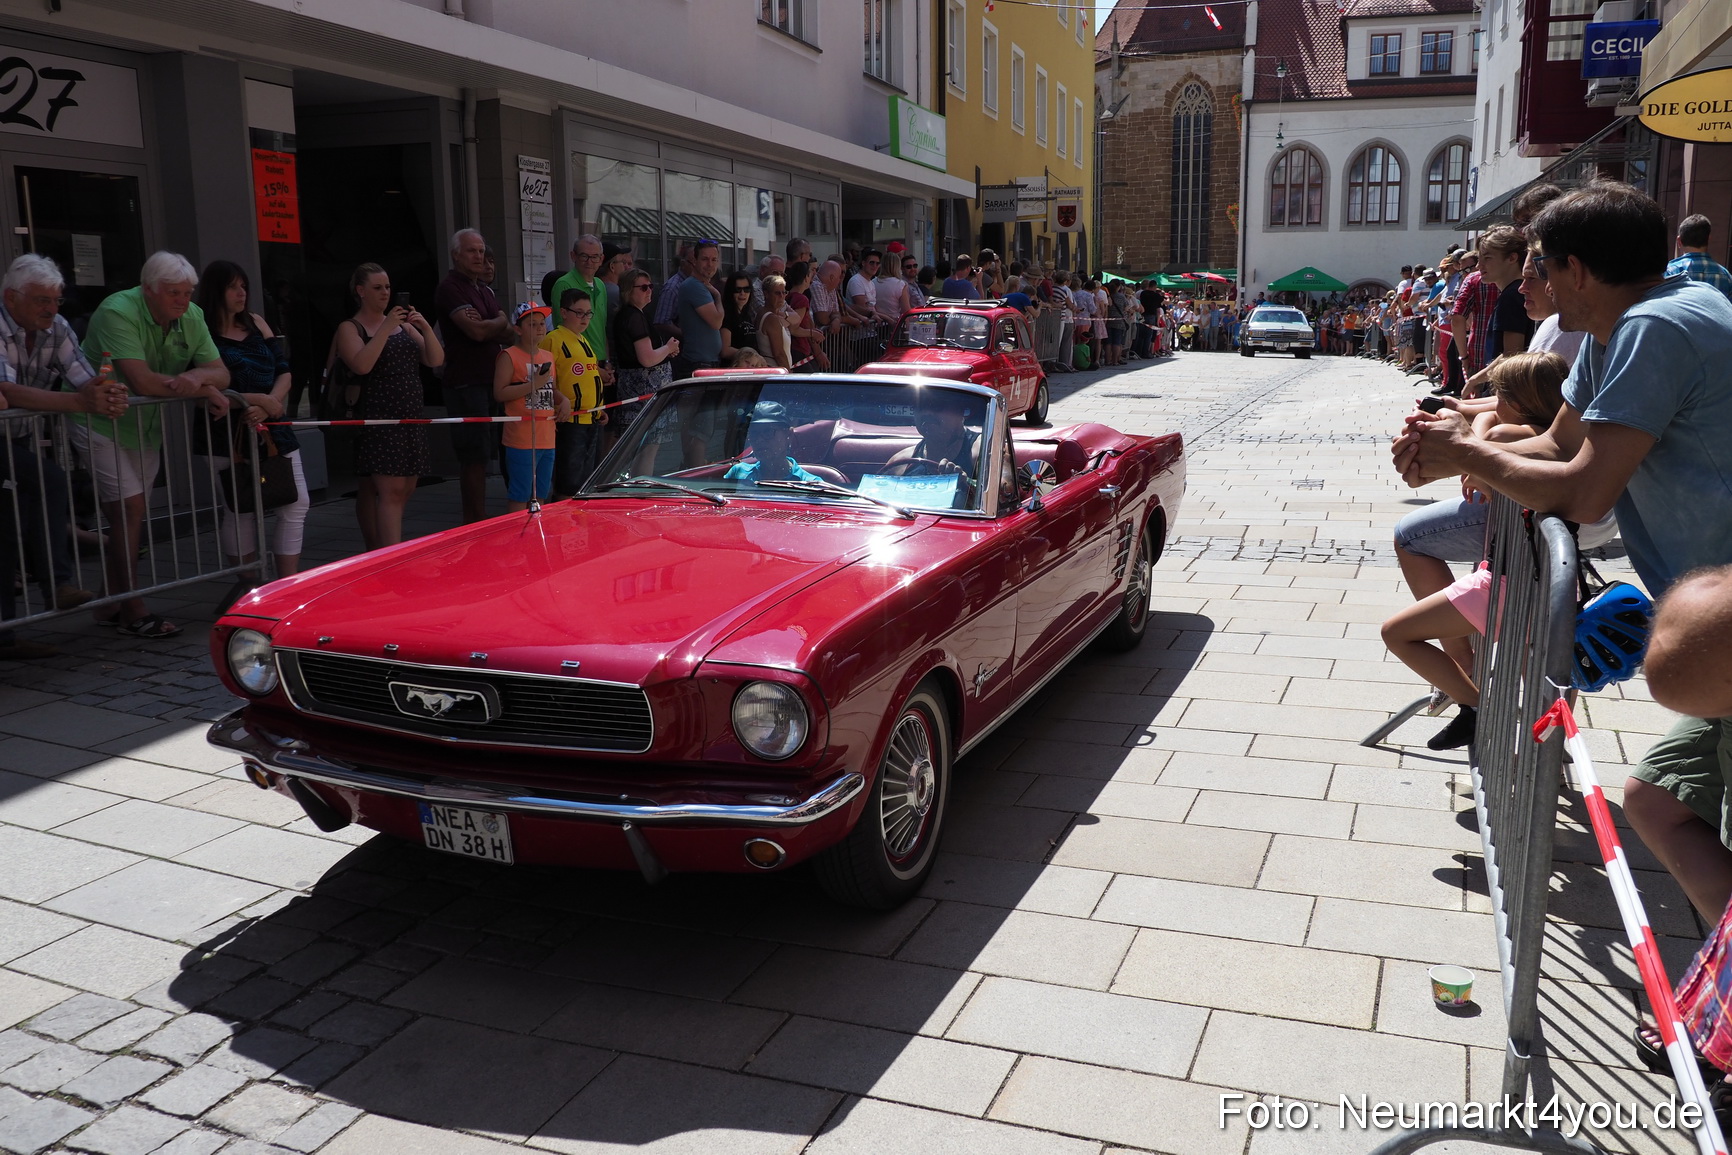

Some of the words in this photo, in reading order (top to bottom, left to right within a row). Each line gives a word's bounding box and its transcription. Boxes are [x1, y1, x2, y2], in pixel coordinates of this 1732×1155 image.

[1591, 37, 1643, 54] CECIL
[1646, 103, 1680, 117] DIE
[1697, 121, 1732, 131] JUTTA
[263, 182, 289, 197] 15%
[522, 176, 550, 198] ke27
[984, 199, 1008, 208] SARAH
[1009, 198, 1015, 207] K
[1009, 375, 1021, 401] 74
[886, 405, 896, 414] SC
[433, 806, 477, 832] NEA
[426, 827, 455, 851] DN
[460, 832, 486, 857] 38
[490, 837, 505, 861] H
